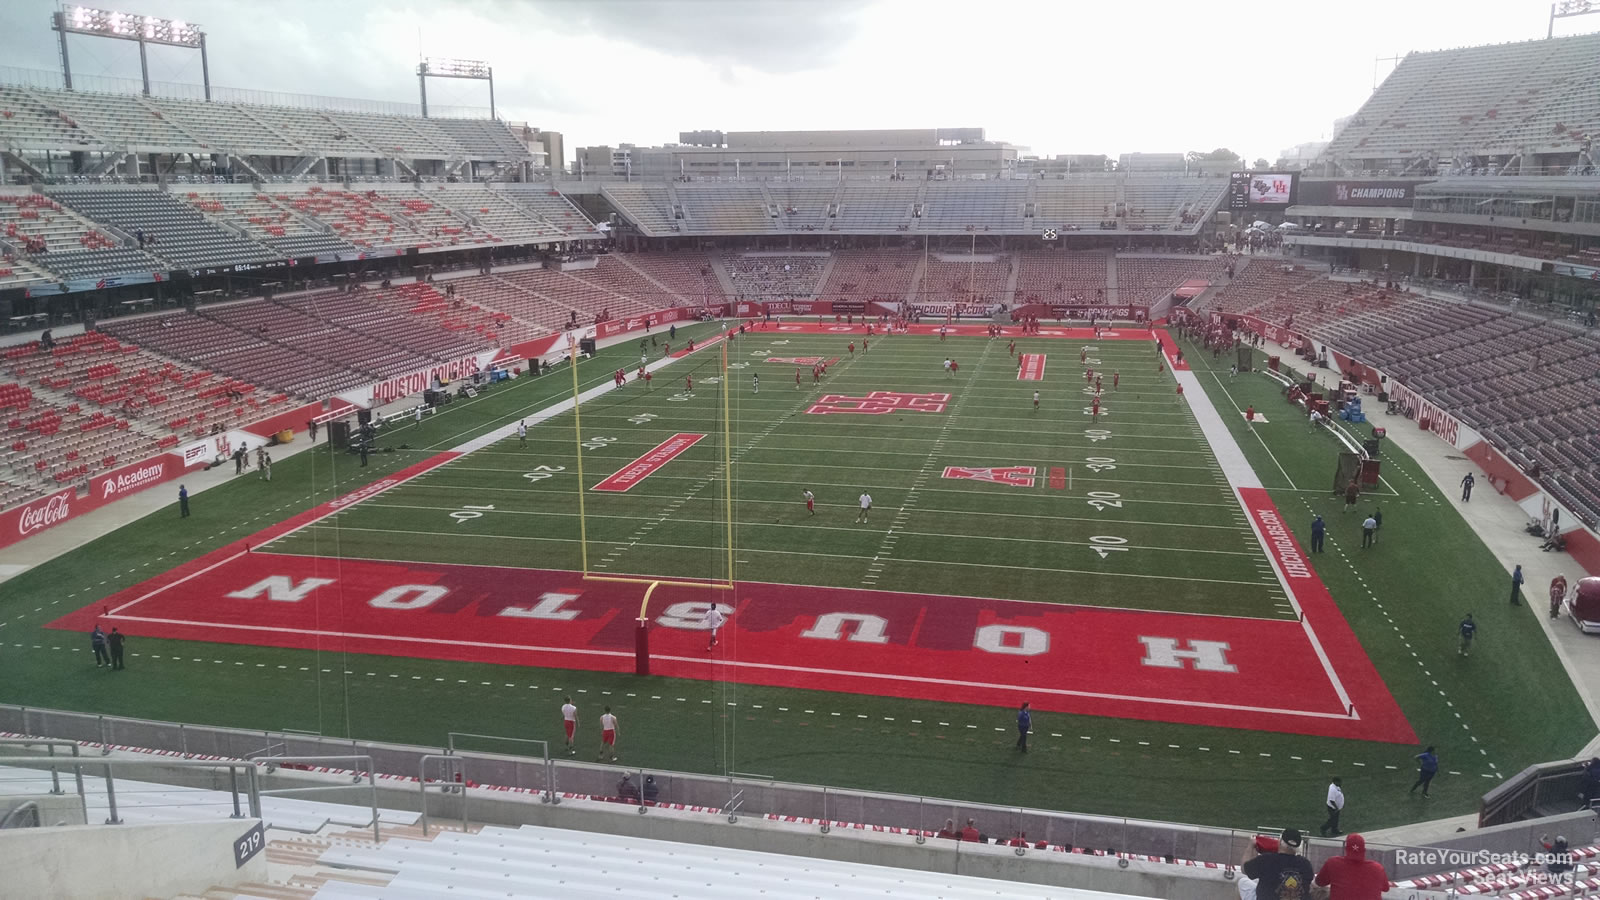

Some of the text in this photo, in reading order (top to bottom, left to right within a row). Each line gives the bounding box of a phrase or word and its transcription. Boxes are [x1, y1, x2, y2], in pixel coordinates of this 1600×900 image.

[1351, 188, 1405, 199] CHAMPIONS
[1044, 230, 1057, 239] 25
[373, 370, 428, 405] HOUSTON
[185, 443, 208, 460] ESPN
[1085, 457, 1117, 470] 30
[117, 463, 164, 489] Academy
[523, 465, 566, 479] 20
[1088, 491, 1123, 508] 20
[449, 505, 495, 519] 10
[1089, 535, 1129, 551] 10
[1256, 509, 1312, 578] UHCOUGARS.COM
[239, 831, 260, 860] 219
